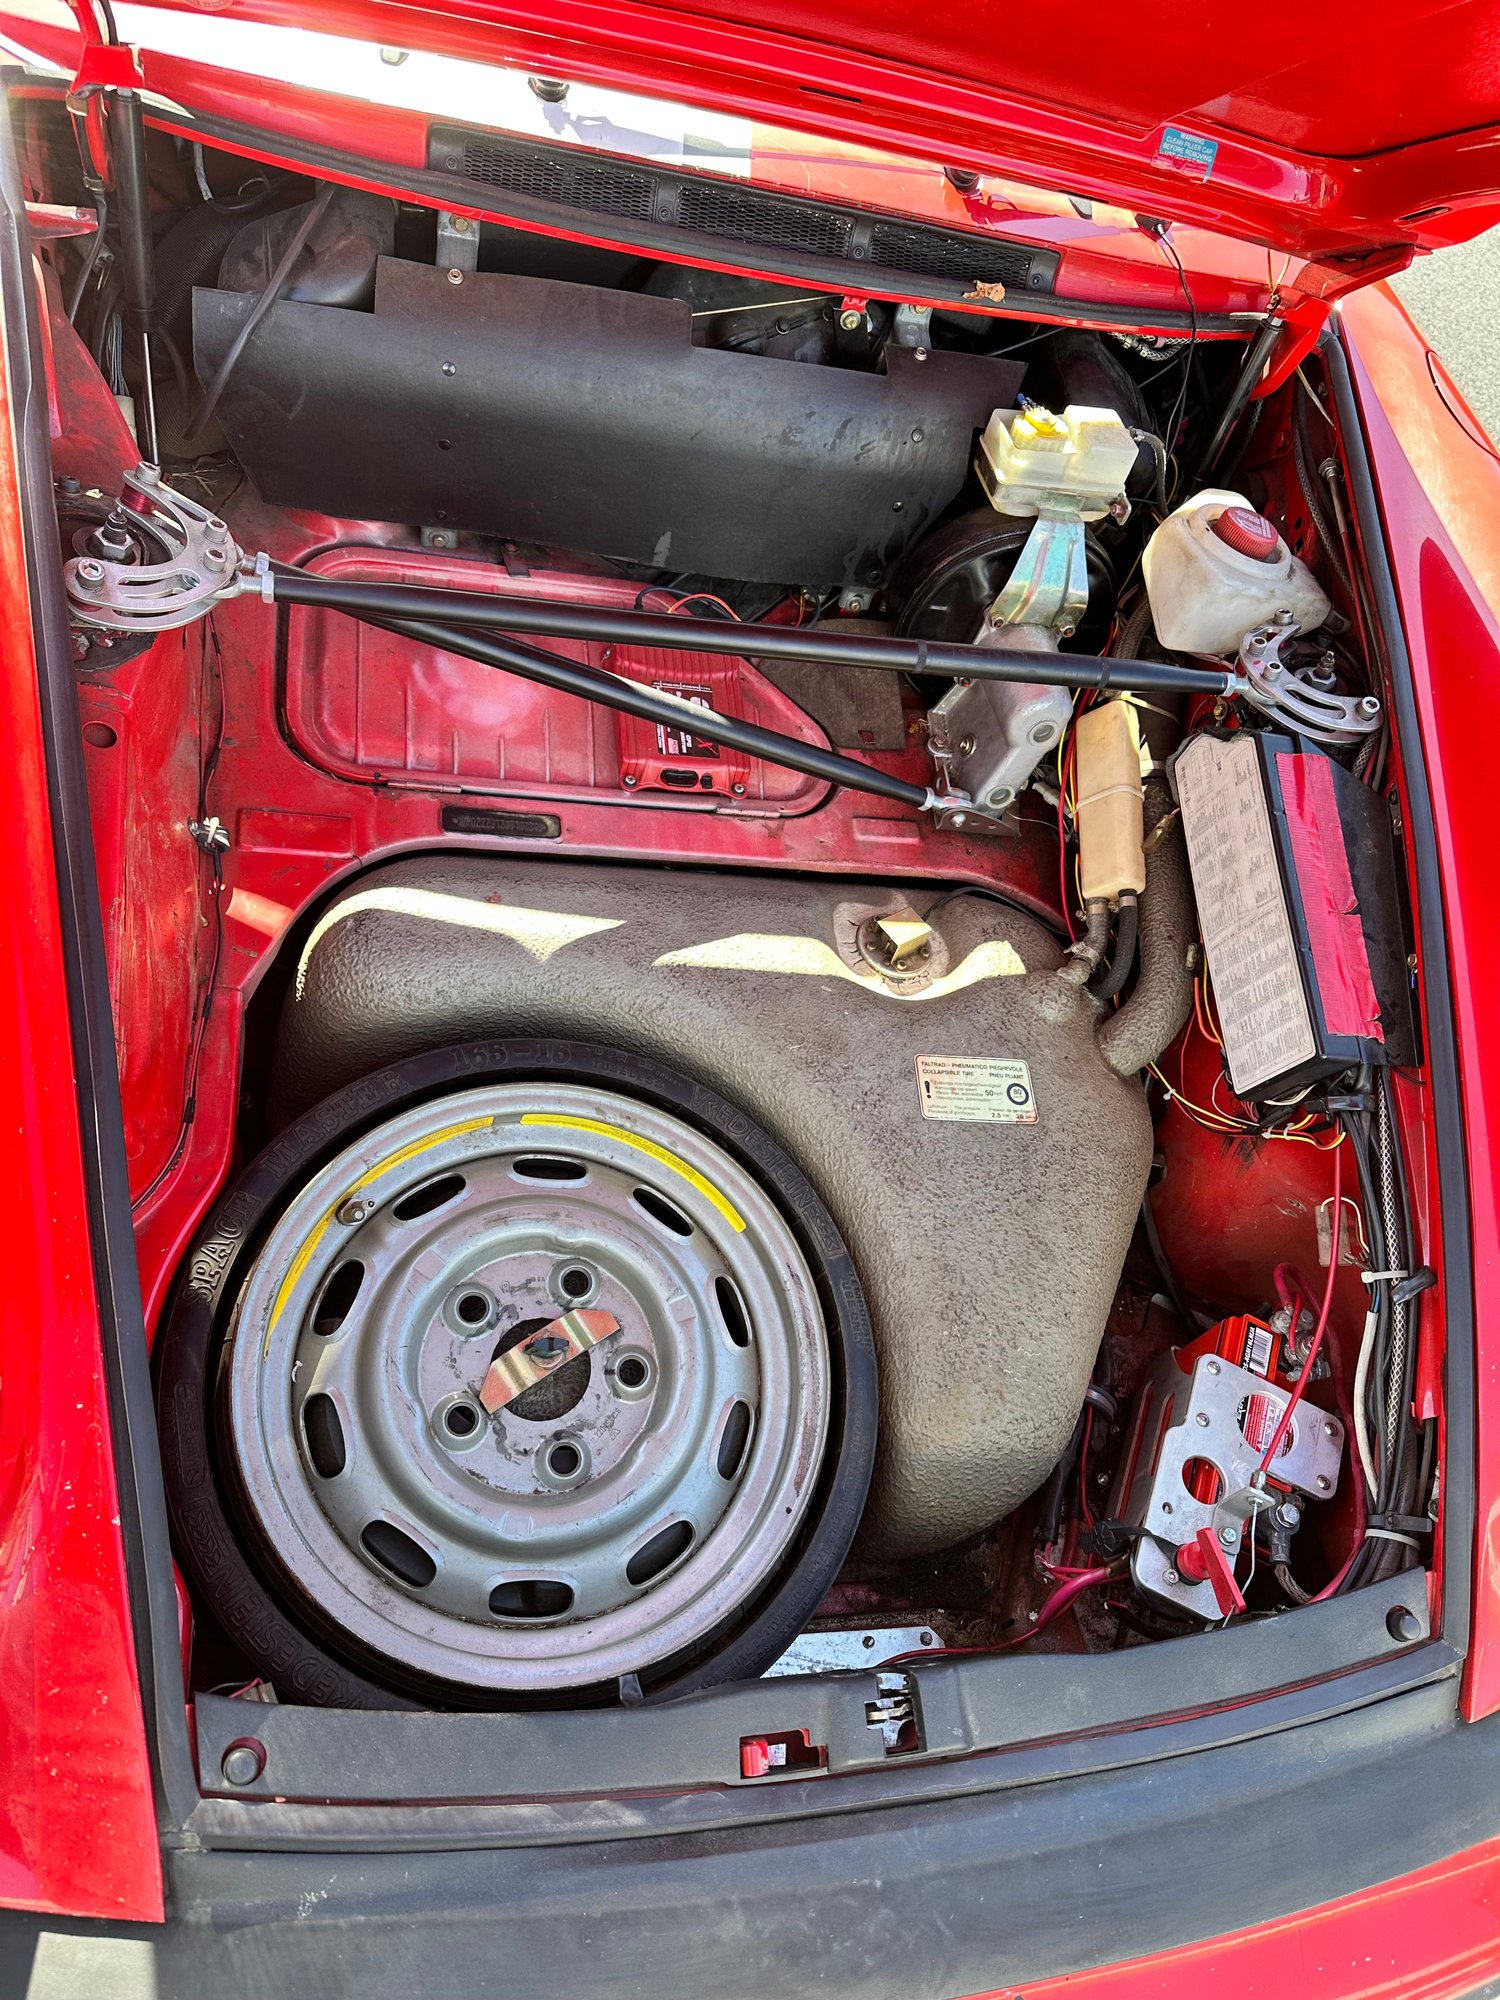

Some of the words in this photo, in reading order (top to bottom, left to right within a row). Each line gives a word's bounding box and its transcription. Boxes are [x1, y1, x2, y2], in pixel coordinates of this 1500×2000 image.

[1163, 142, 1184, 154] BEFORE
[1185, 148, 1212, 162] REMOVING
[1166, 135, 1184, 145] CLEAN
[1184, 141, 1201, 151] FILLER
[1201, 146, 1213, 155] CAP
[591, 1060, 666, 1091] TUBELESS
[260, 1070, 409, 1180] MASTER
[689, 1084, 814, 1217] VREDESTEIN
[182, 1192, 257, 1303] SPACE
